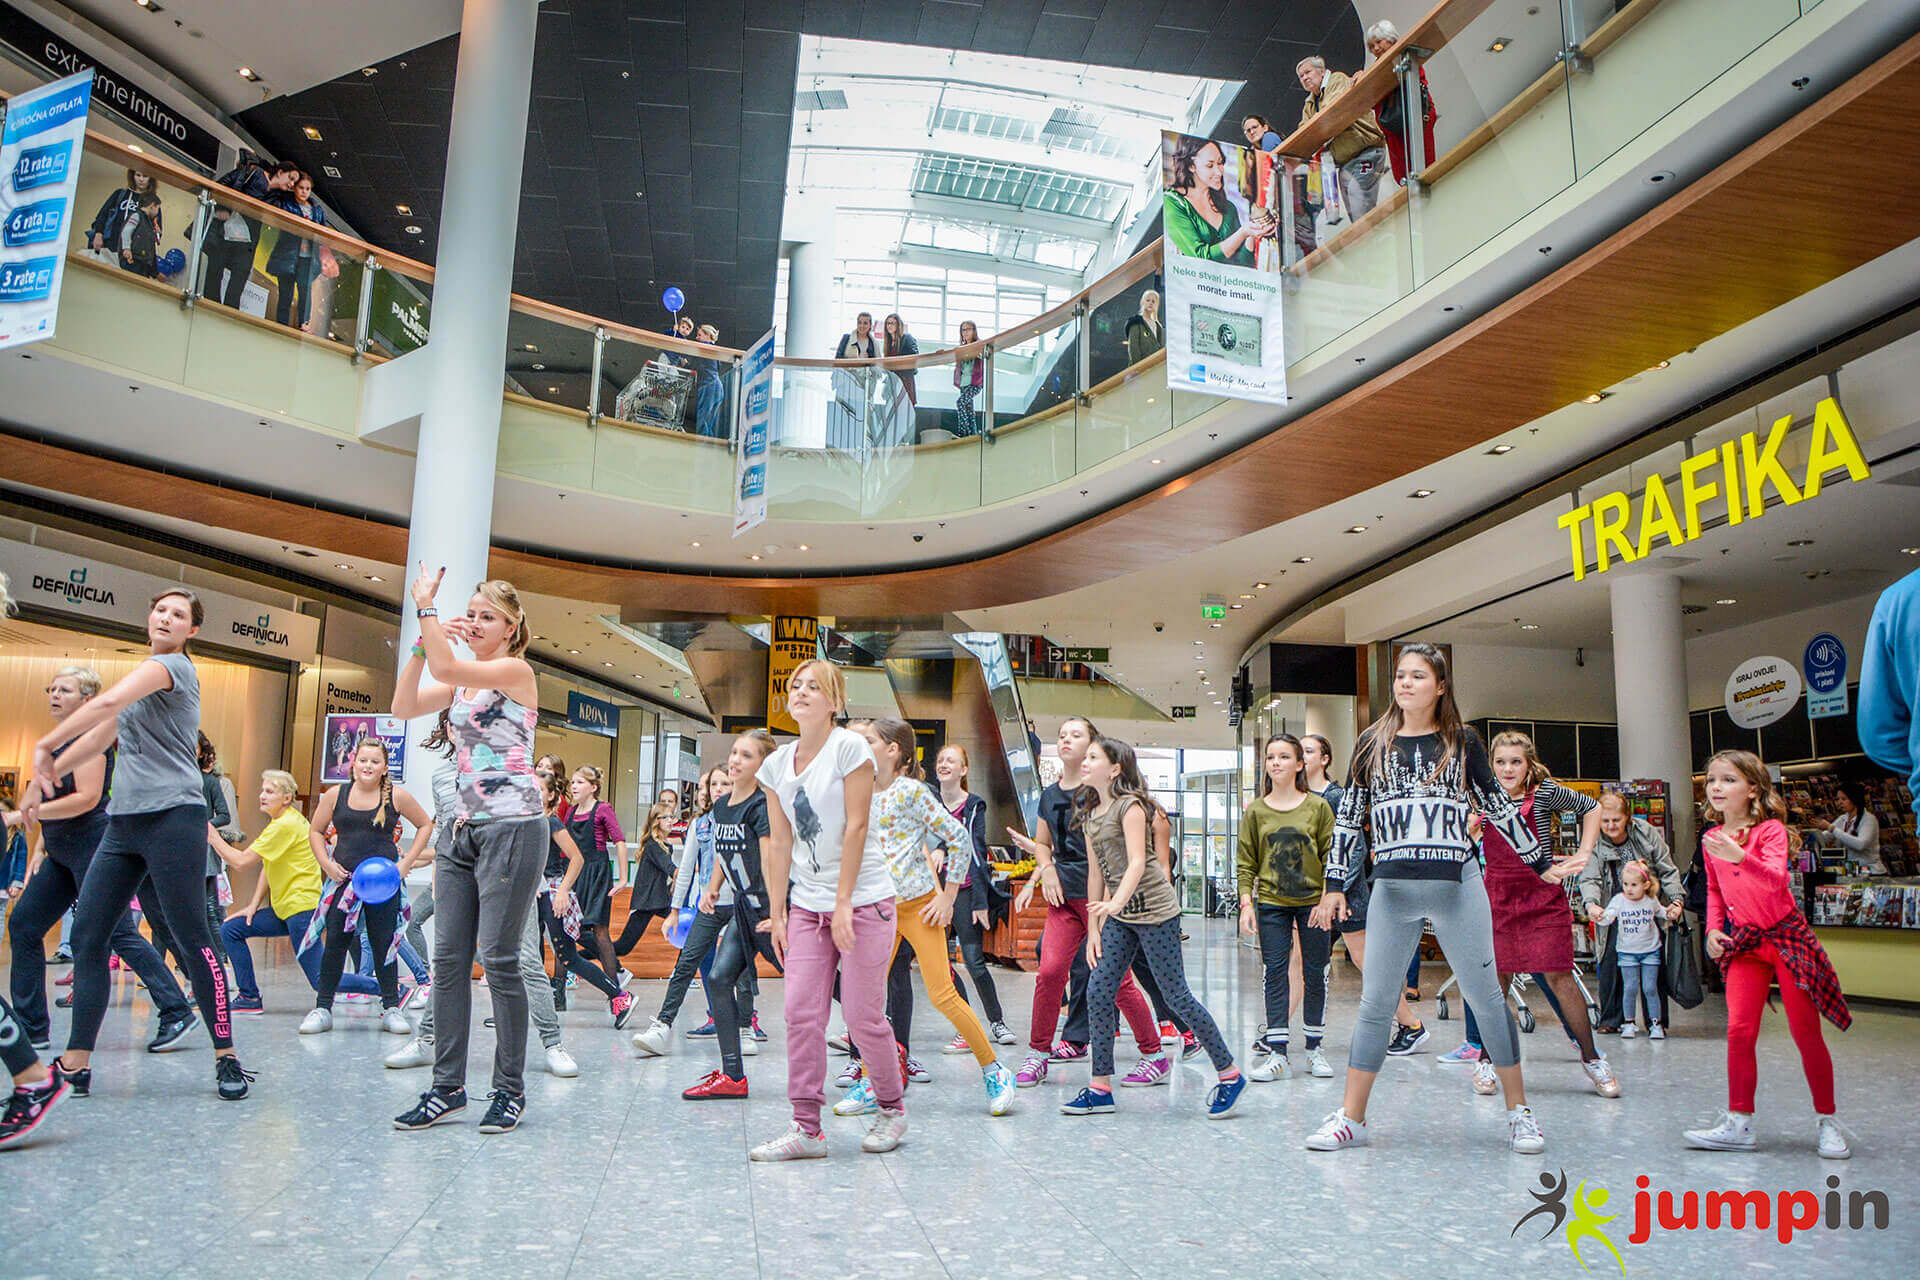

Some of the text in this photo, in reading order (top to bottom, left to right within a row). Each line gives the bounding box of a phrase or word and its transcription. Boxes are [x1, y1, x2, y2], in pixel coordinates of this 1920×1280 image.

[45, 42, 187, 141] extrme intimo
[49, 95, 82, 117] OTPLATA
[20, 154, 52, 176] 12 rata
[12, 211, 43, 231] 6 rata
[2, 269, 36, 287] 3 rate
[1173, 265, 1277, 293] Neke stvari jednostavno
[1197, 283, 1256, 302] morate imati.
[1557, 397, 1872, 582] TRAFIKA
[32, 575, 115, 605] DEFINICIJA
[232, 621, 289, 647] DEFINICIJA
[1736, 664, 1777, 684] IGRAJ OVDJE!
[326, 682, 371, 705] Pametno
[1374, 803, 1414, 845] NW
[1418, 848, 1454, 861] STATEN
[1621, 908, 1653, 918] maybe
[1622, 917, 1652, 926] maybe
[1624, 926, 1639, 934] not
[201, 947, 228, 1022] ENERGETICS
